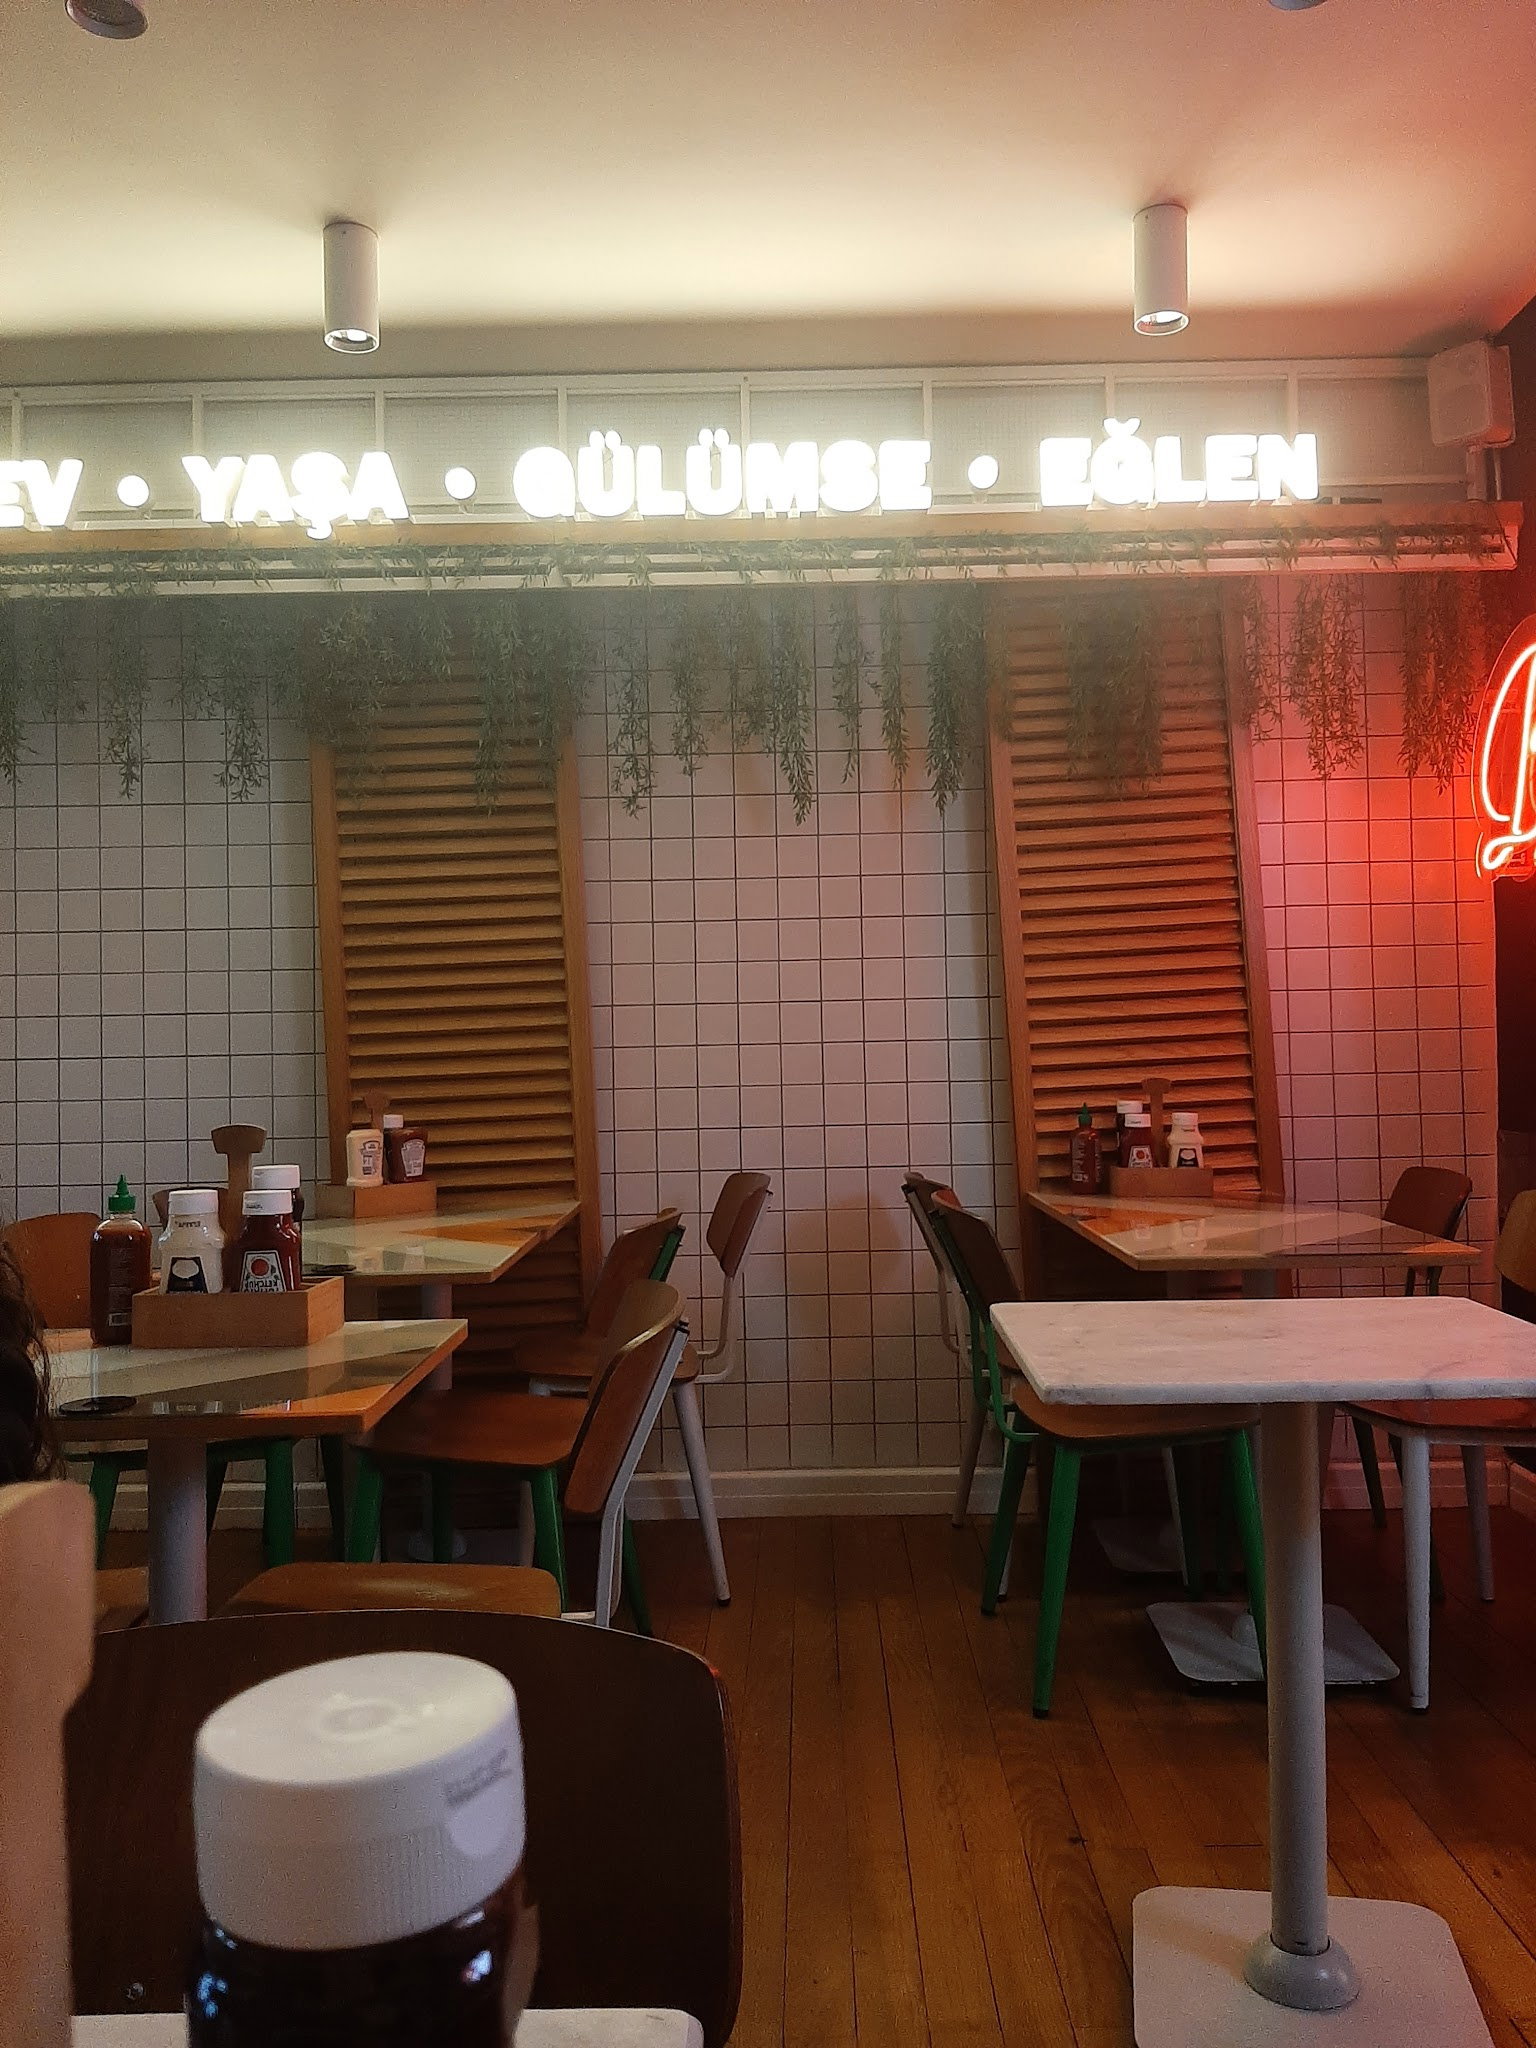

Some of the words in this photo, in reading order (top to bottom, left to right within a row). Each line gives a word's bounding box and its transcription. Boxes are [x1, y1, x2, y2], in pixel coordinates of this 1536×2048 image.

[181, 451, 409, 539] YAŞA
[512, 430, 933, 518] GÜLÜMSE
[1039, 418, 1319, 508] EĞLEN
